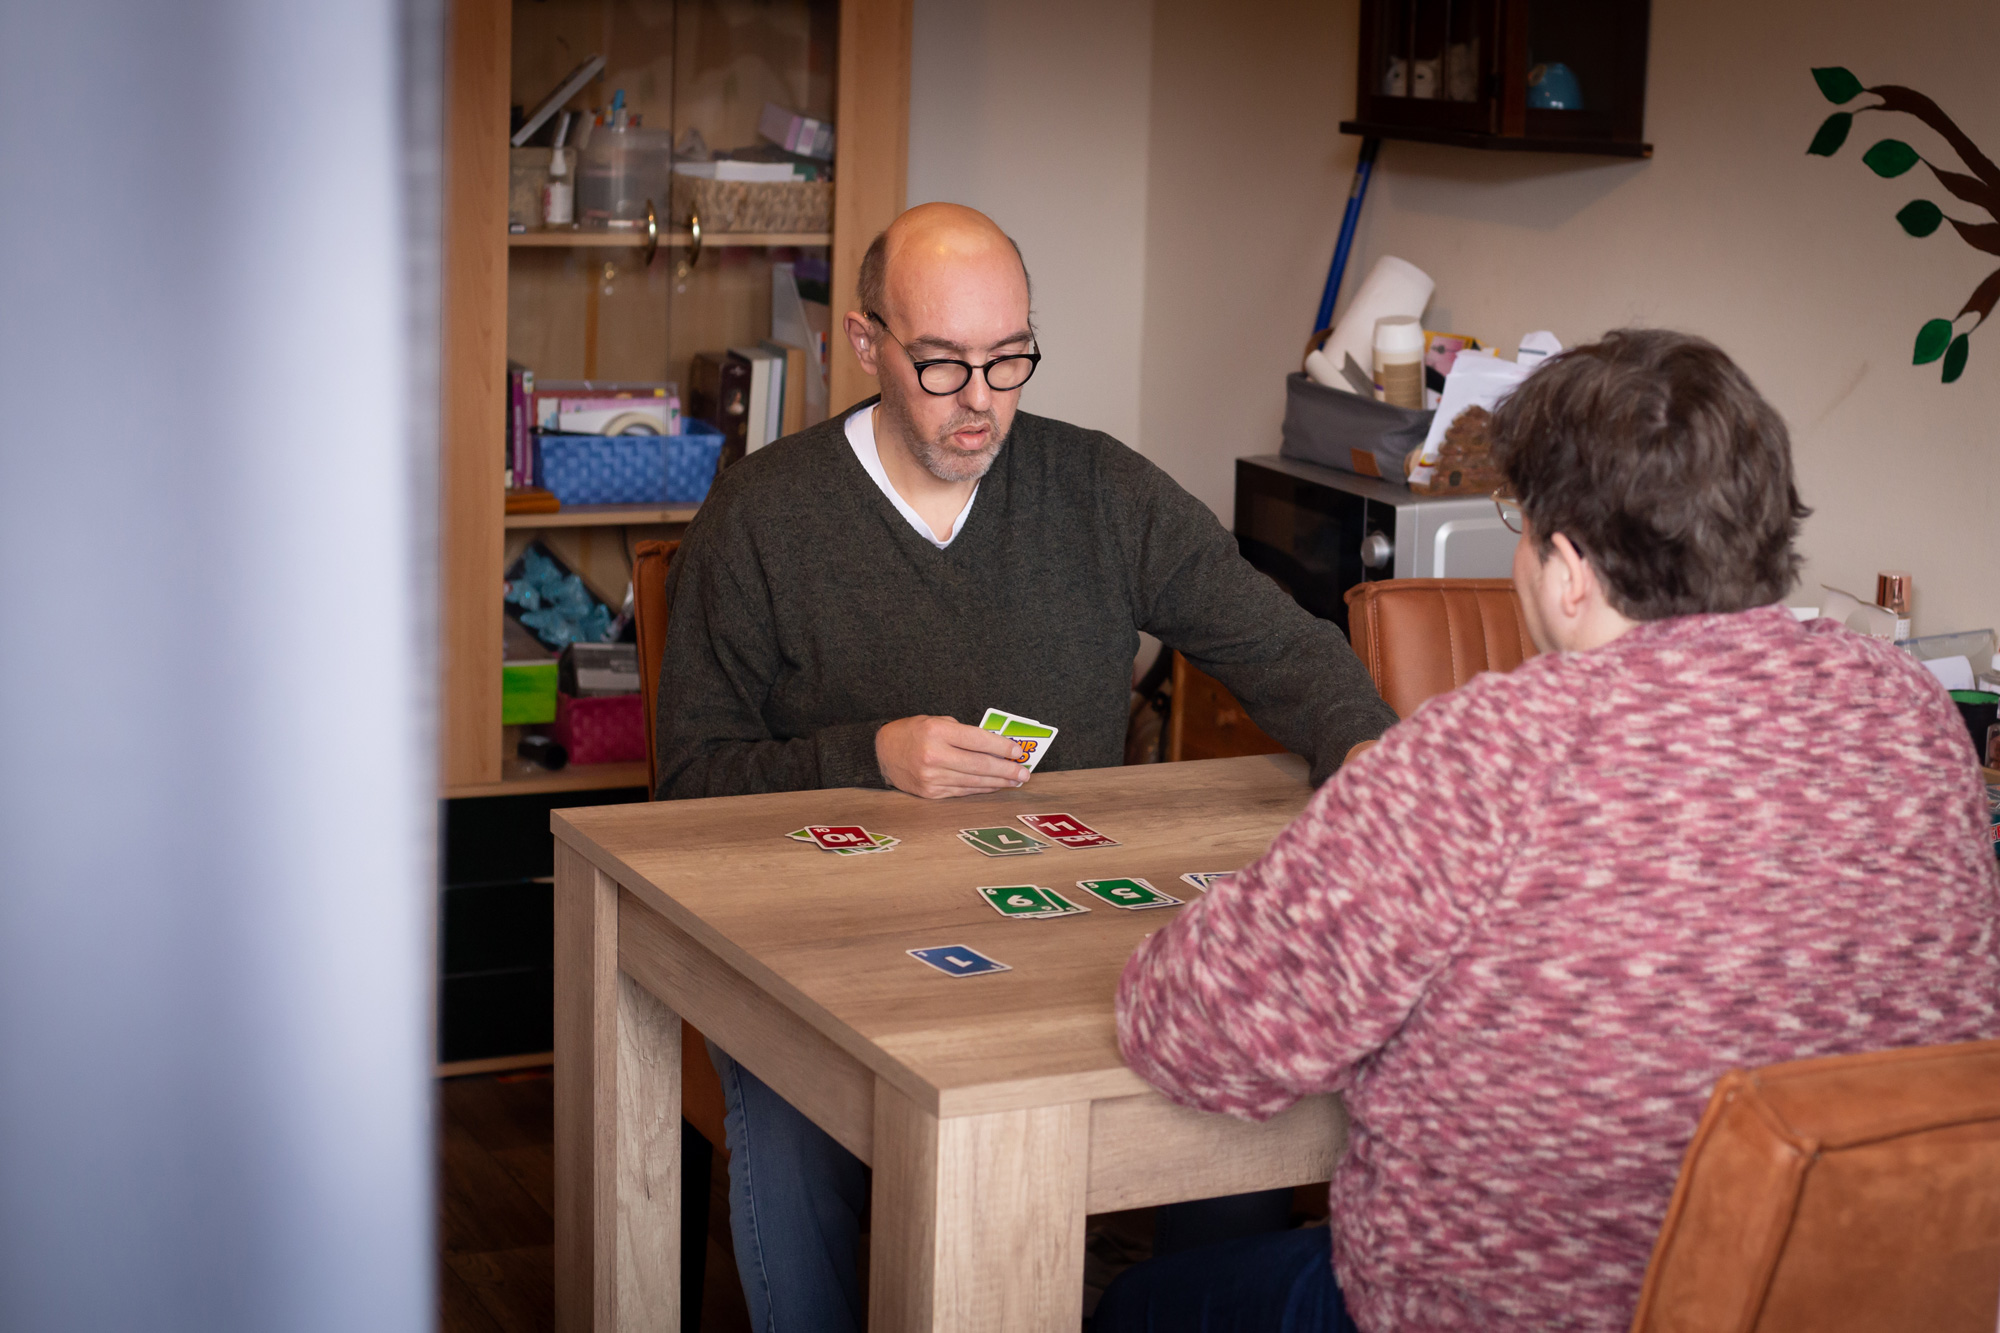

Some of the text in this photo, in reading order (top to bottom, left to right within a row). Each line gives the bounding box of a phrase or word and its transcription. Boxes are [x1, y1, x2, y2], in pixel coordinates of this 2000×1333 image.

[1038, 821, 1077, 831] 11
[822, 833, 865, 842] 10
[998, 834, 1022, 844] 7
[1111, 888, 1142, 899] 5
[1007, 895, 1034, 906] 6
